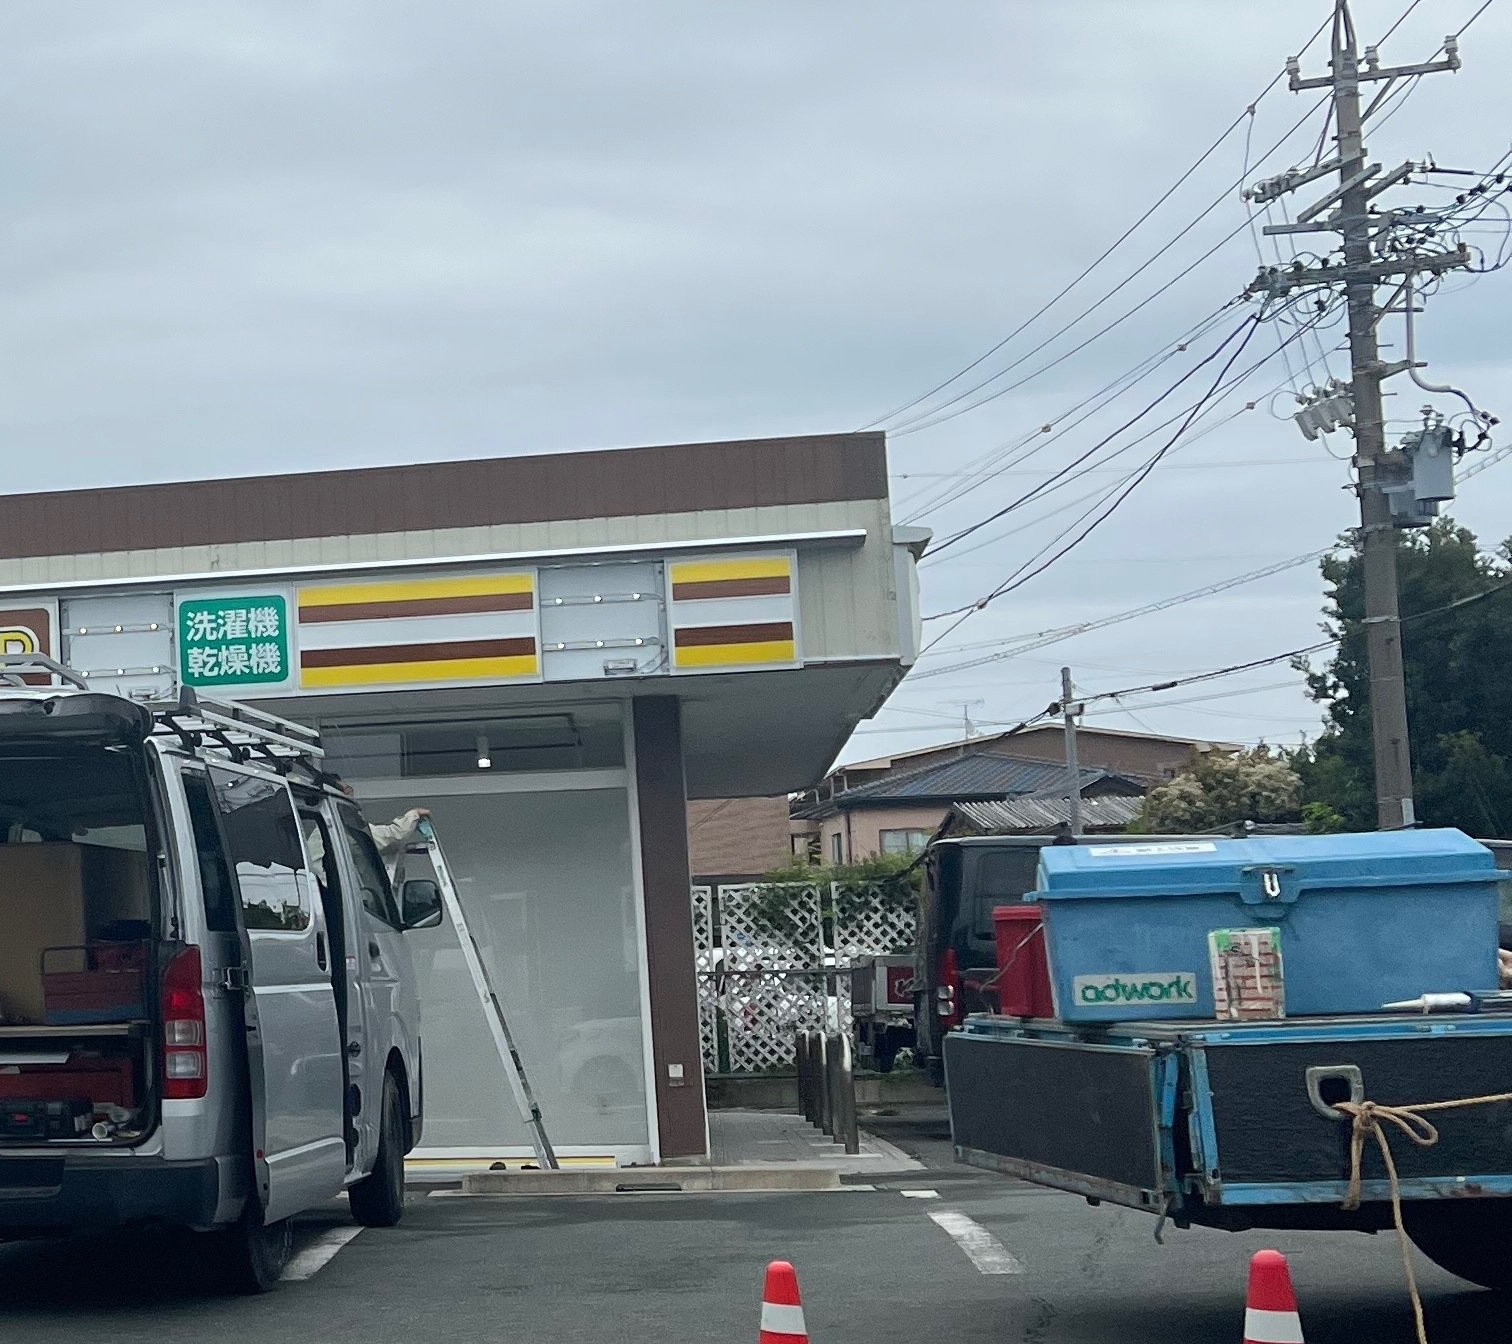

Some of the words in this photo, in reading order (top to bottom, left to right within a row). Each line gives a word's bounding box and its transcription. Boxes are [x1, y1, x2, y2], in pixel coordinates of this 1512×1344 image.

[186, 606, 279, 641] 洗濯機
[187, 642, 281, 677] 乾燥機
[1081, 975, 1193, 1003] adwork
